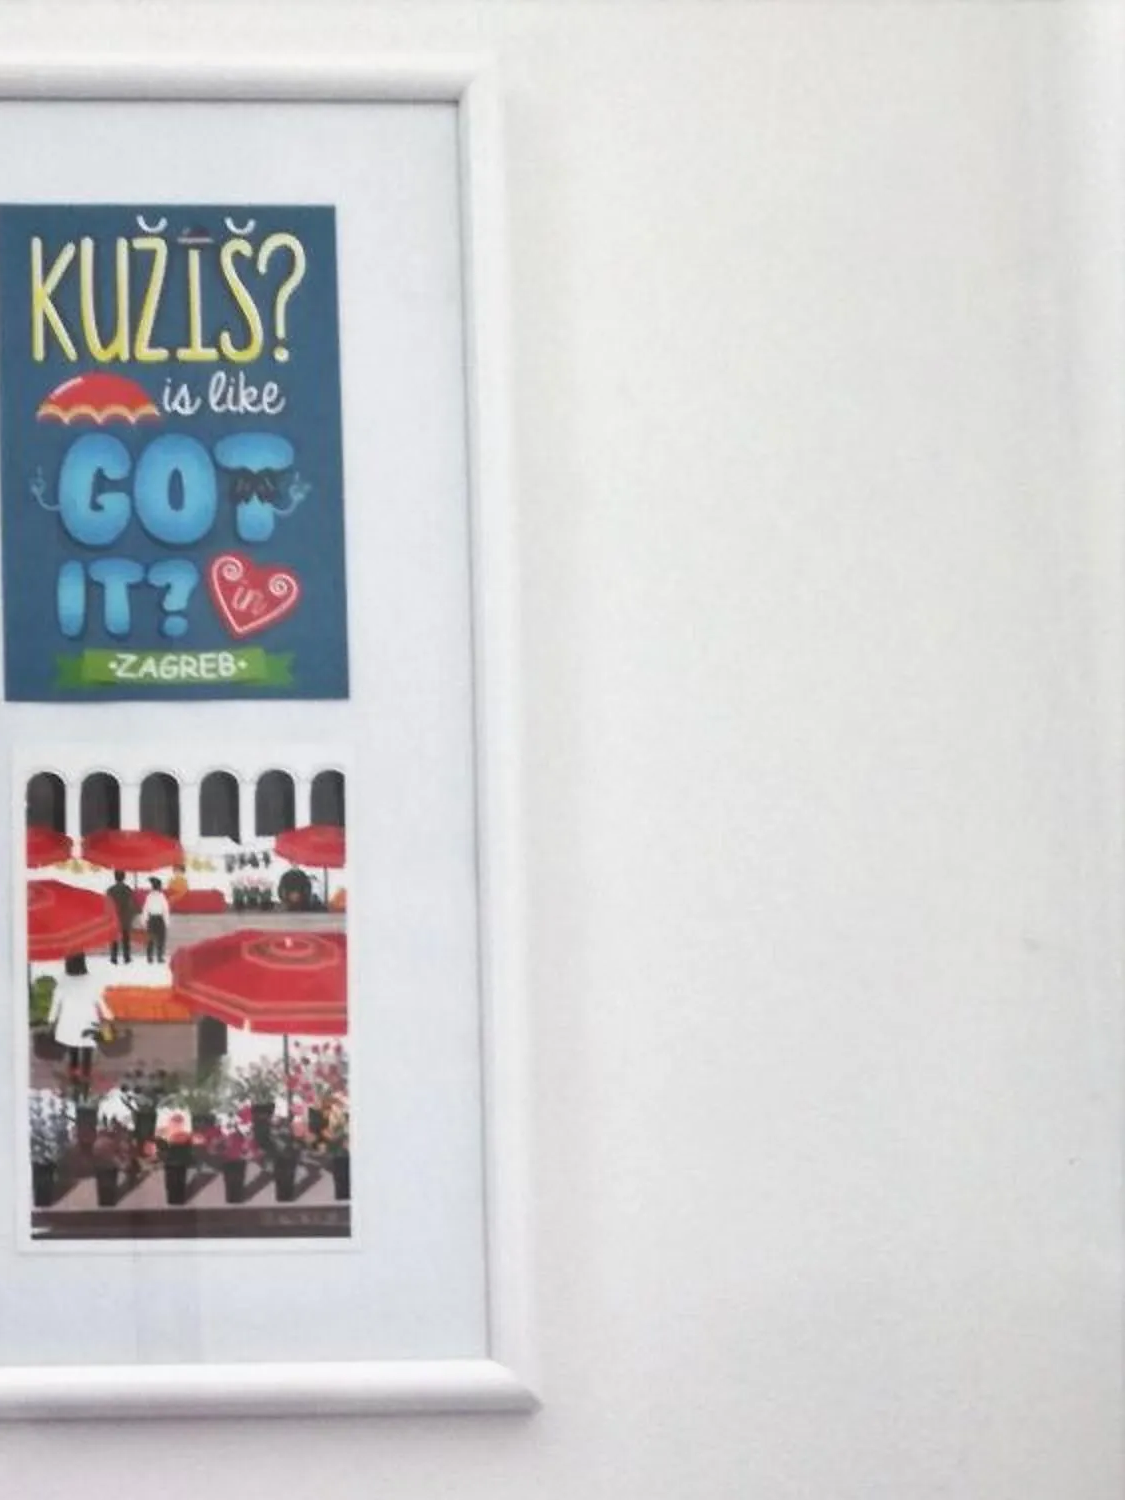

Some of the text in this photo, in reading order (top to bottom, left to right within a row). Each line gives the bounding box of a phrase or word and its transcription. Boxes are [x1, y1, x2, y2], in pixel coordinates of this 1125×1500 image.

[31, 215, 306, 362] KUŽIŠ?
[162, 370, 285, 416] is like
[58, 431, 294, 545] GOT
[57, 557, 199, 637] IT?
